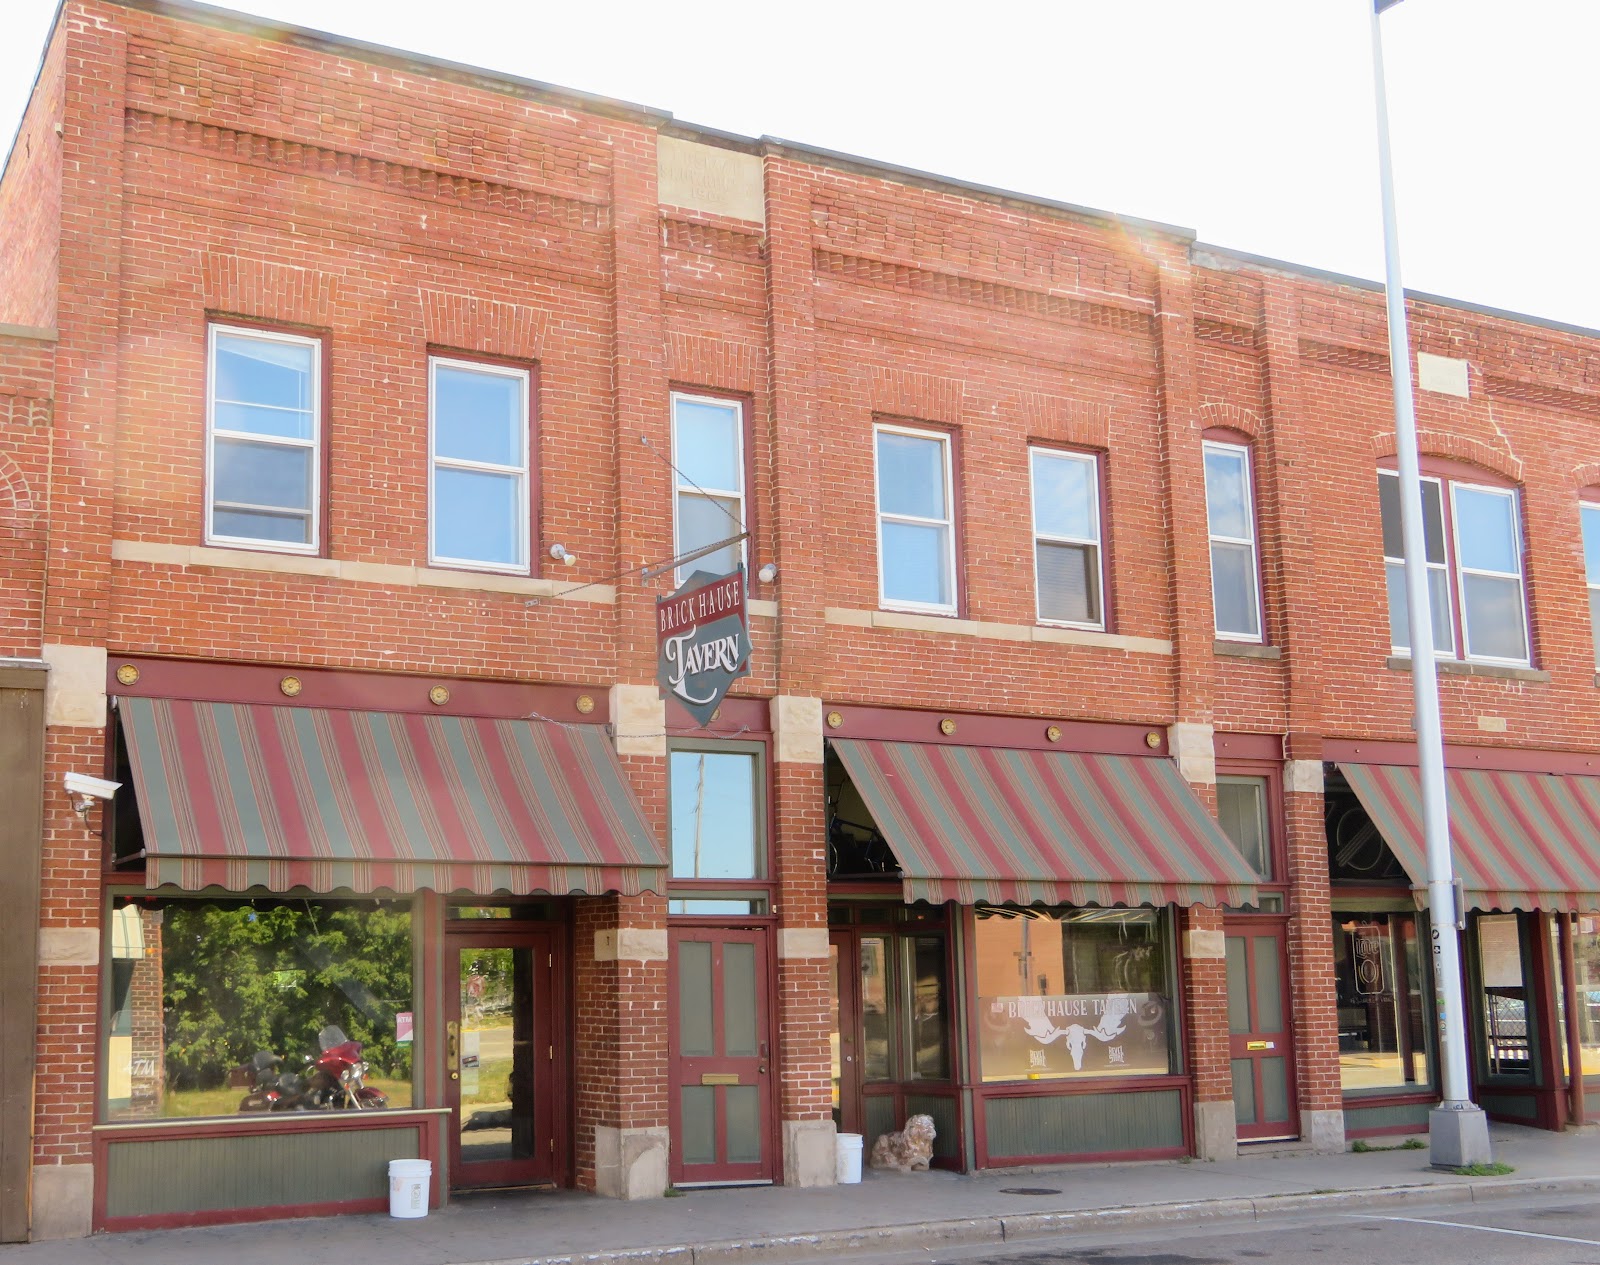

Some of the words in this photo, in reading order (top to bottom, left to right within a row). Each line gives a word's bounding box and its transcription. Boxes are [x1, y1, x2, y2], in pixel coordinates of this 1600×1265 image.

[660, 597, 696, 632] BRICK
[698, 580, 740, 619] HAUSE
[665, 624, 740, 704] TAVERN
[1092, 997, 1137, 1016] TAN
[398, 1015, 413, 1023] ATM
[123, 1058, 155, 1076] ATM
